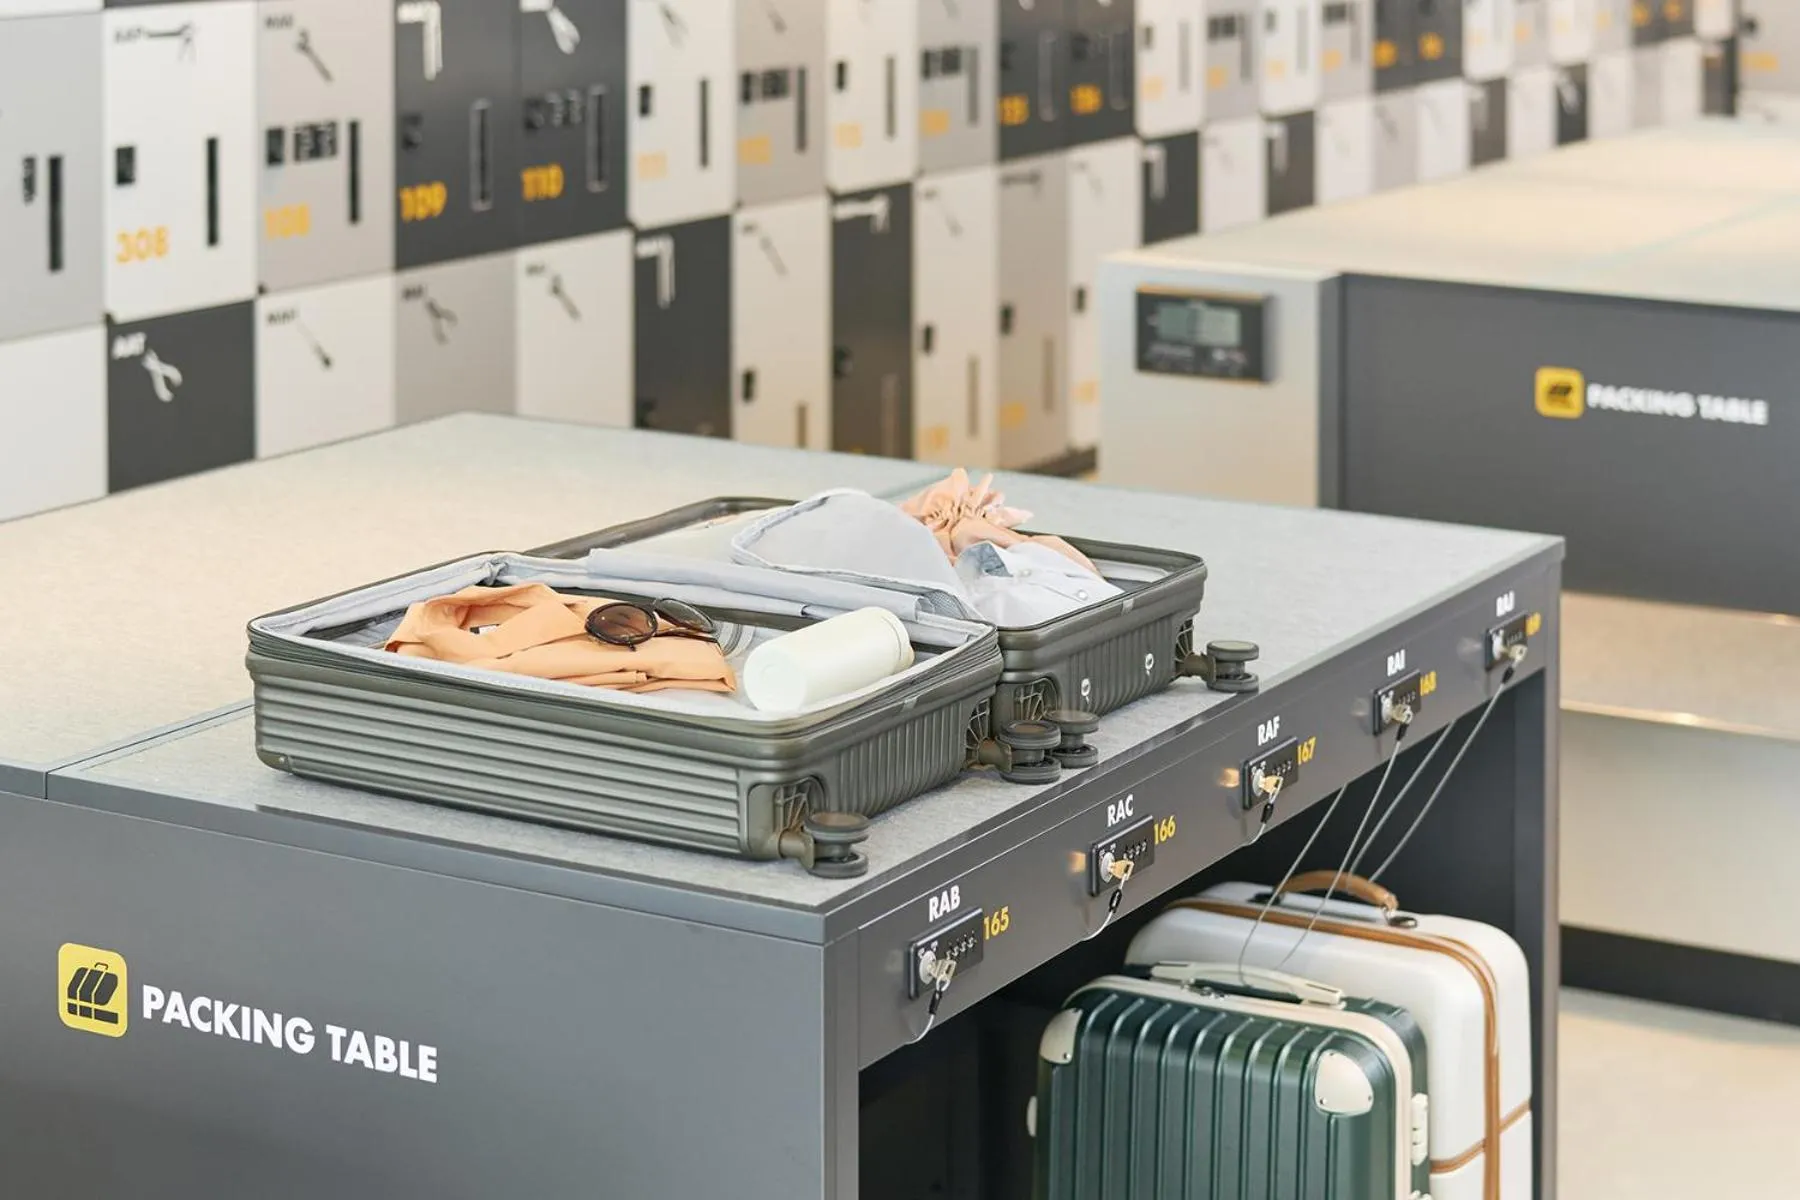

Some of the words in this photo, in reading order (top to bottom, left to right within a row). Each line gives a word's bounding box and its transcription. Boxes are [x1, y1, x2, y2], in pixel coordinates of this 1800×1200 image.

[116, 226, 170, 264] 308
[1586, 382, 1696, 418] PACKING
[1697, 393, 1769, 426] TABLE
[1386, 649, 1407, 677] RAI
[1257, 715, 1281, 746] RAF
[1296, 736, 1317, 766] 167
[1106, 793, 1135, 828] RAC
[1153, 815, 1177, 846] 166
[928, 884, 962, 923] RAB
[983, 905, 1011, 941] 165
[142, 984, 316, 1055] PACKING
[325, 1023, 438, 1084] TABLE
